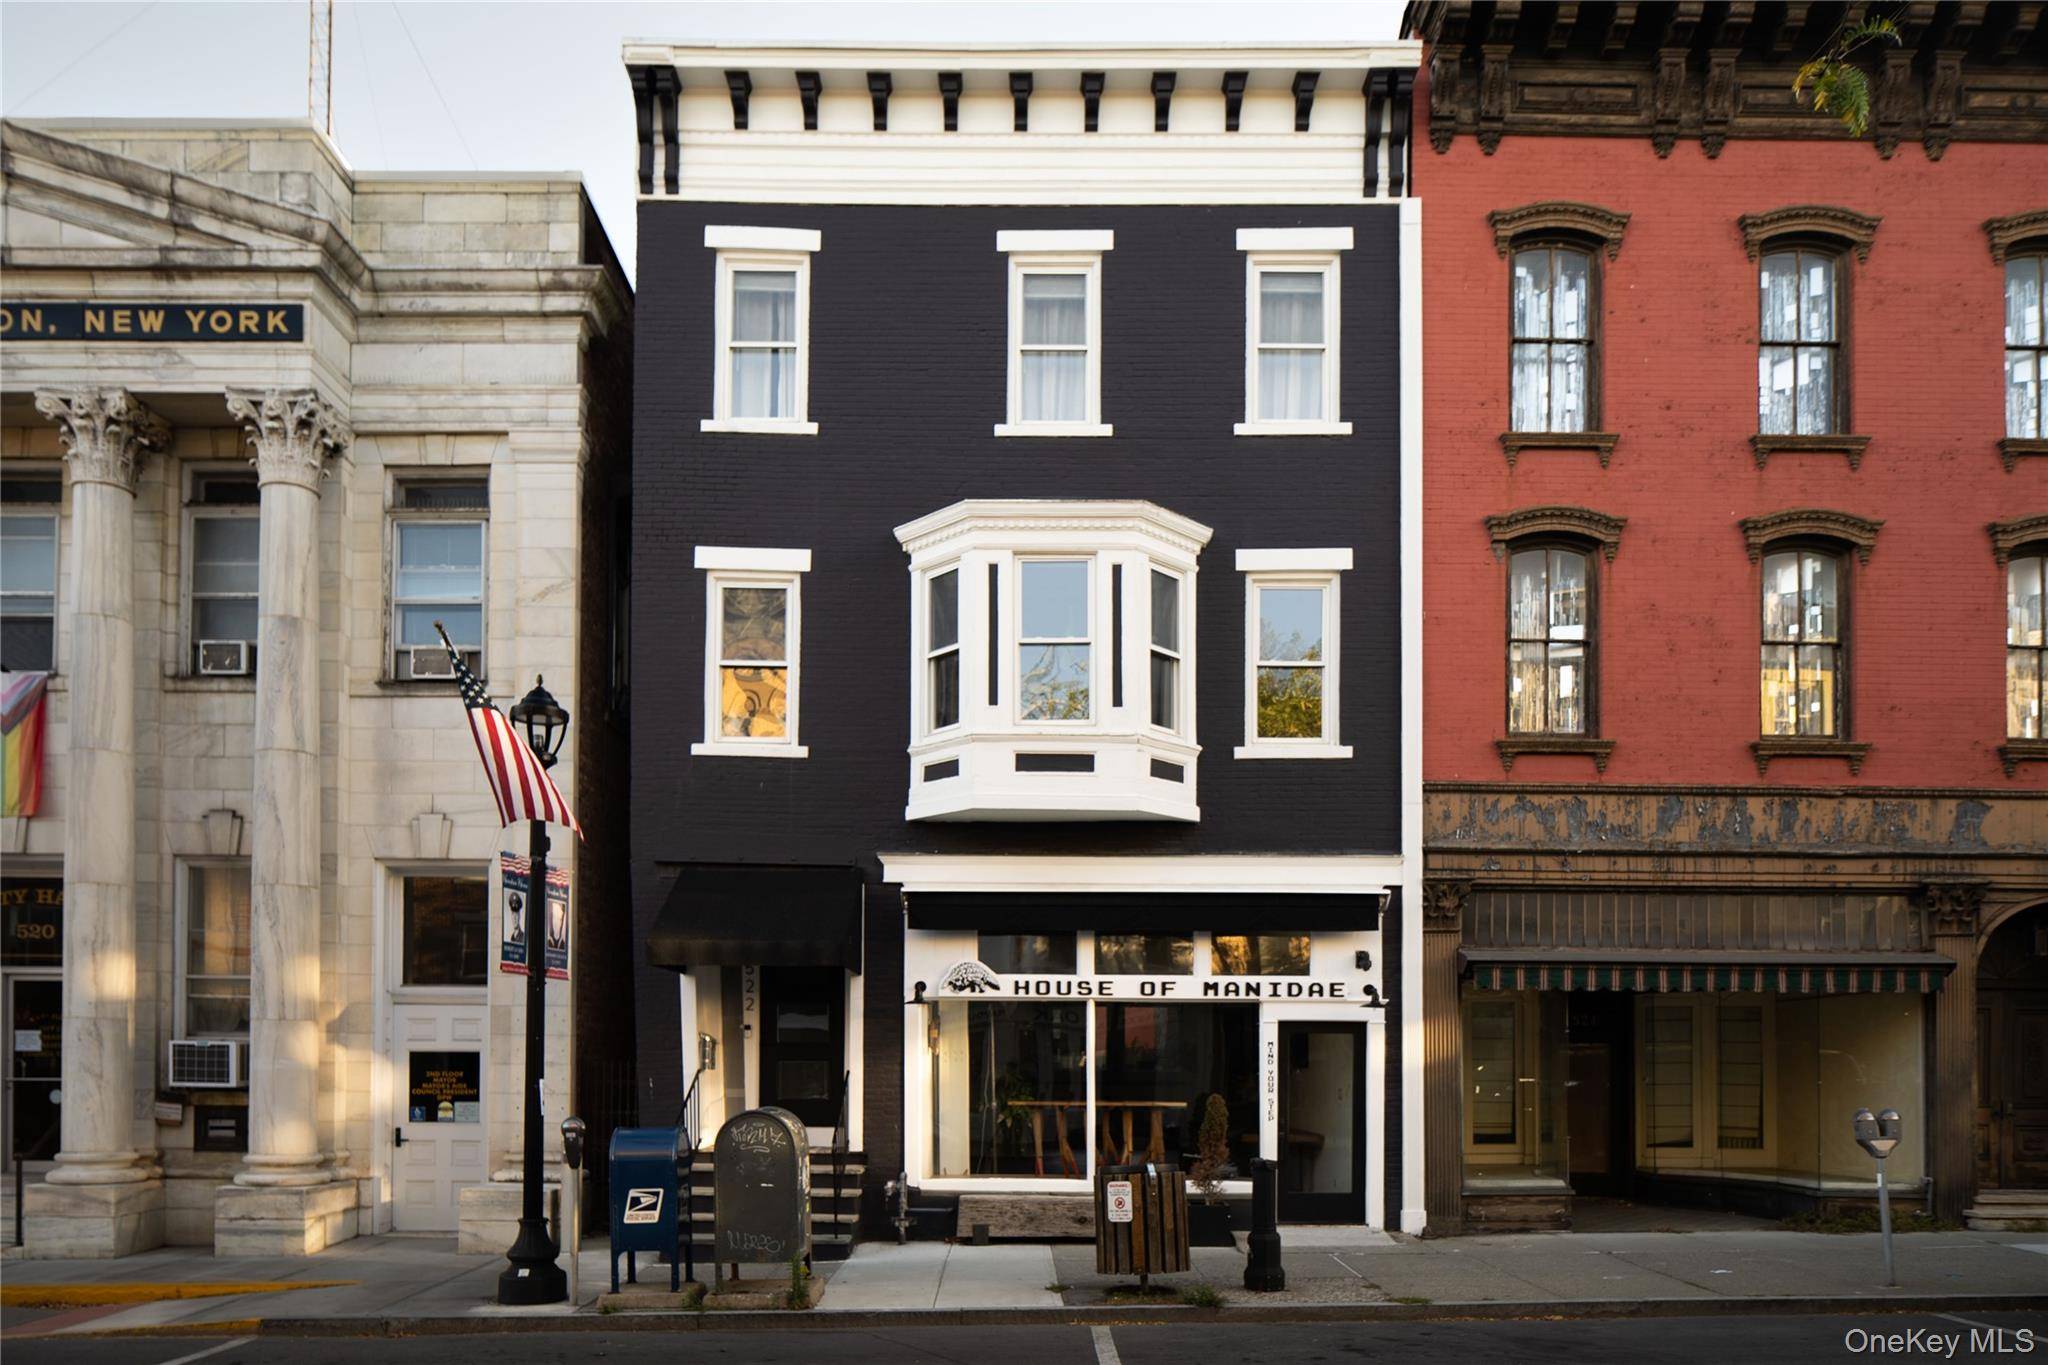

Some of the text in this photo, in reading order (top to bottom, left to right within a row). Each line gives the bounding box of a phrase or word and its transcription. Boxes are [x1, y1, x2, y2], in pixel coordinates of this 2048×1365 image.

[84, 309, 165, 333] NEW
[185, 309, 289, 333] YORK
[16, 923, 55, 940] 520
[1014, 980, 1345, 997] HOUSE OF MANIDAE
